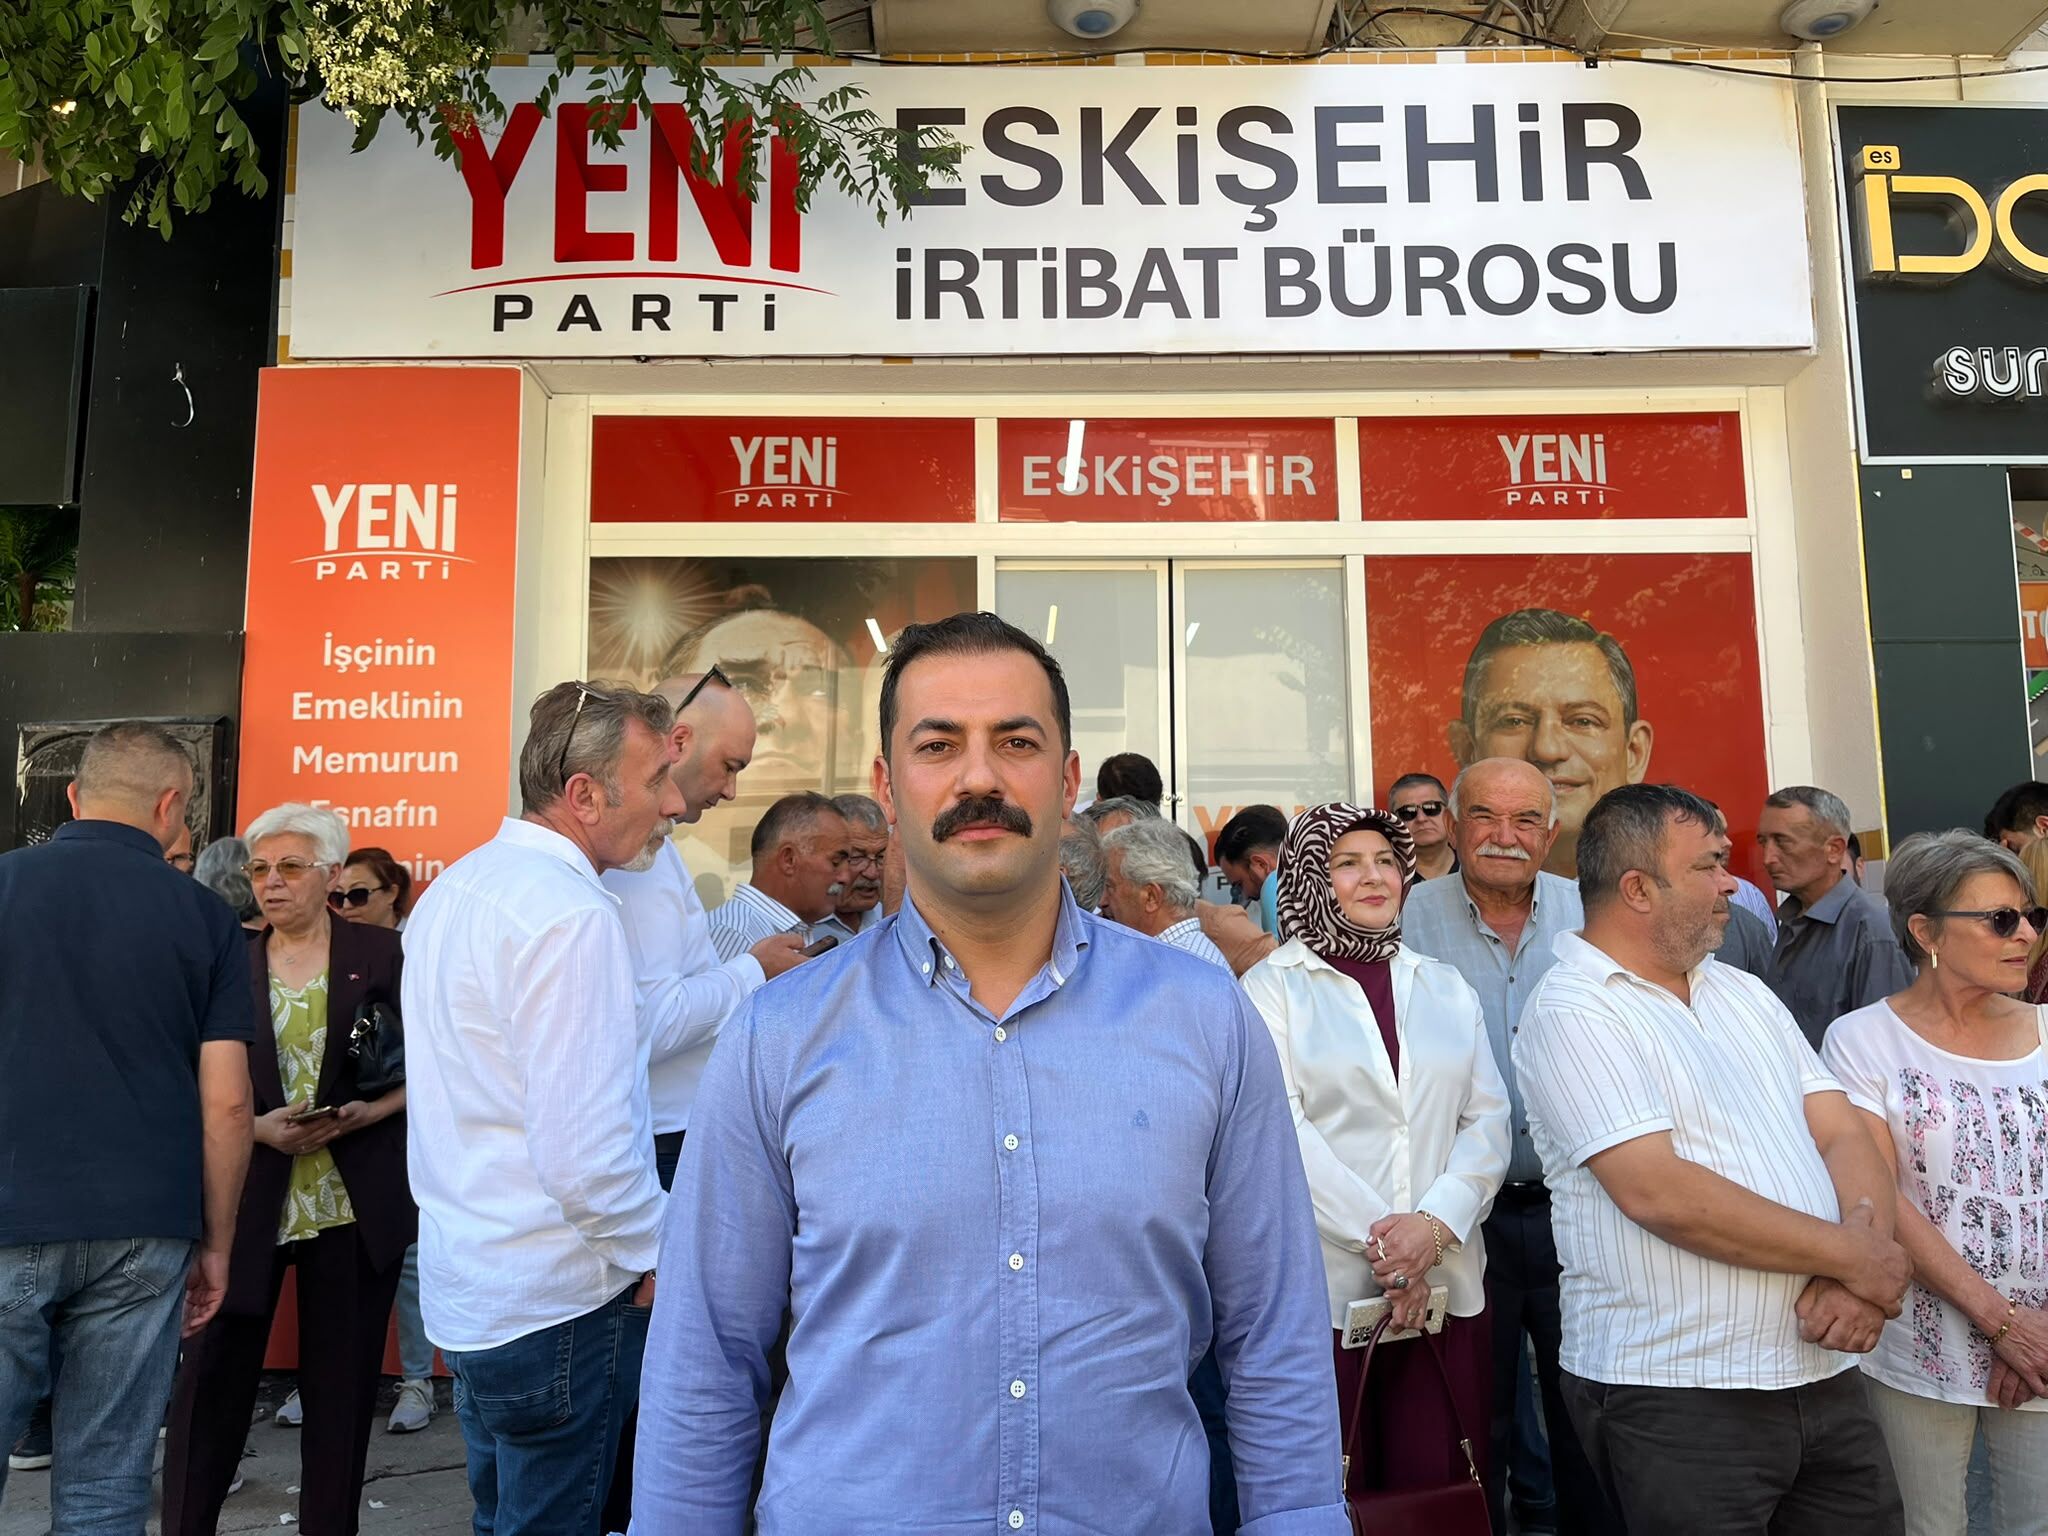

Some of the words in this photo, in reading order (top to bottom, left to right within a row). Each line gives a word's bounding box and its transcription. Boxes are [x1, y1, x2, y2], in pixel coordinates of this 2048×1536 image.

[1265, 228, 1678, 318] BÜROSU
[323, 632, 436, 673] İşçinin
[292, 690, 463, 721] Emeklinin
[292, 744, 459, 775] Memurun
